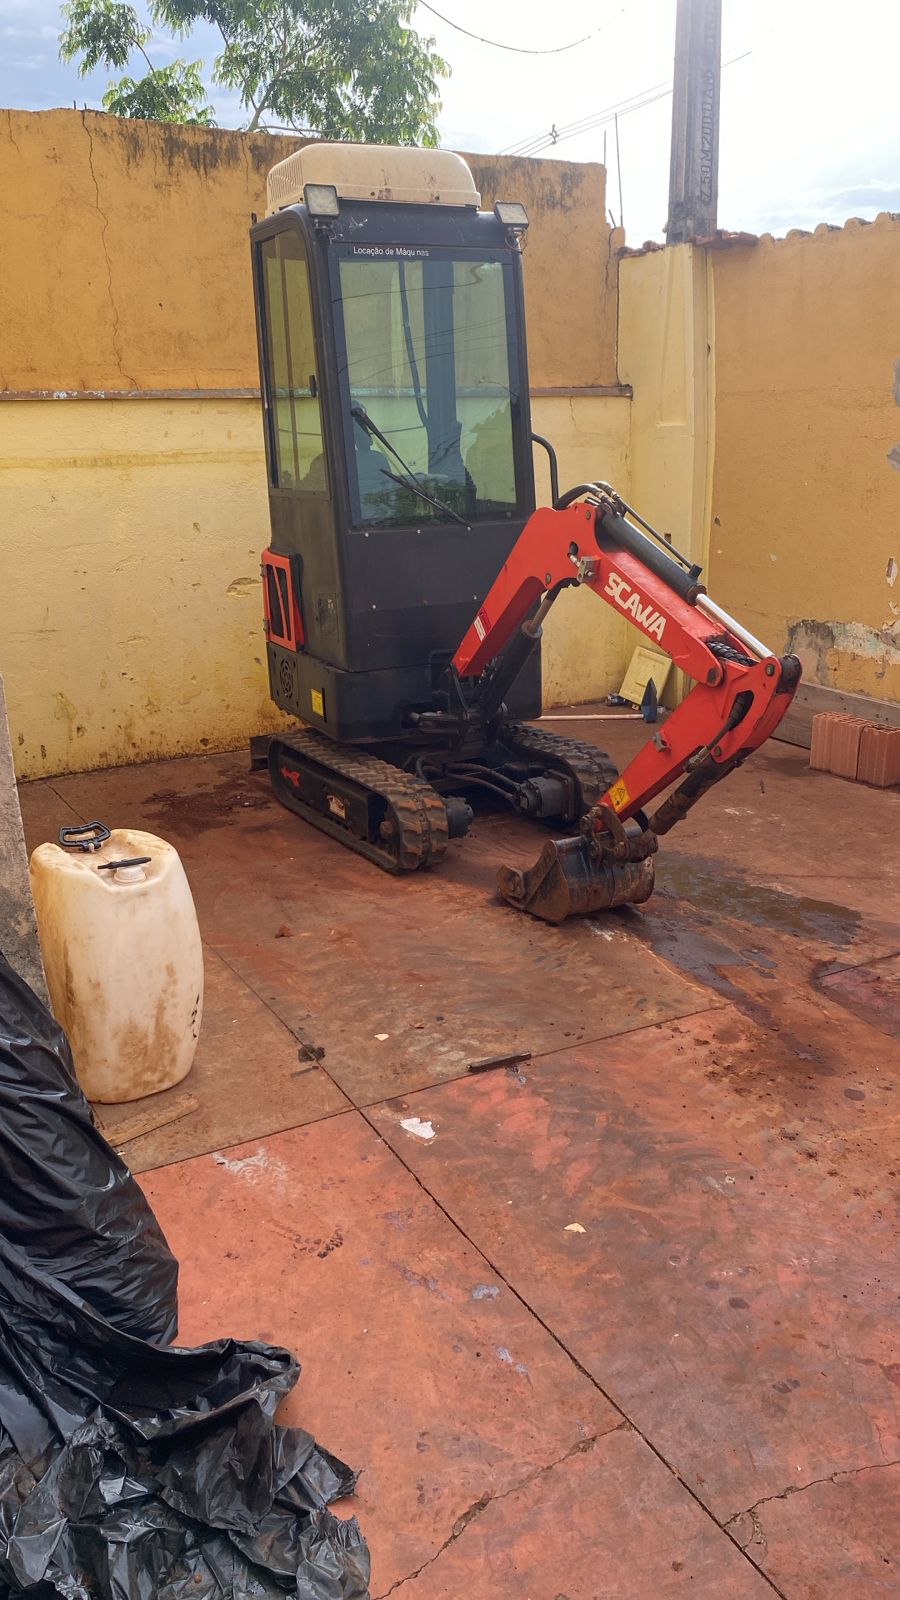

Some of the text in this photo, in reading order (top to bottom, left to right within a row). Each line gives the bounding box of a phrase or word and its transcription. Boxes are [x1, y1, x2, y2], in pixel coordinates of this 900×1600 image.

[353, 246, 430, 257] Locação de Máqunas
[604, 572, 667, 641] SCAWA
